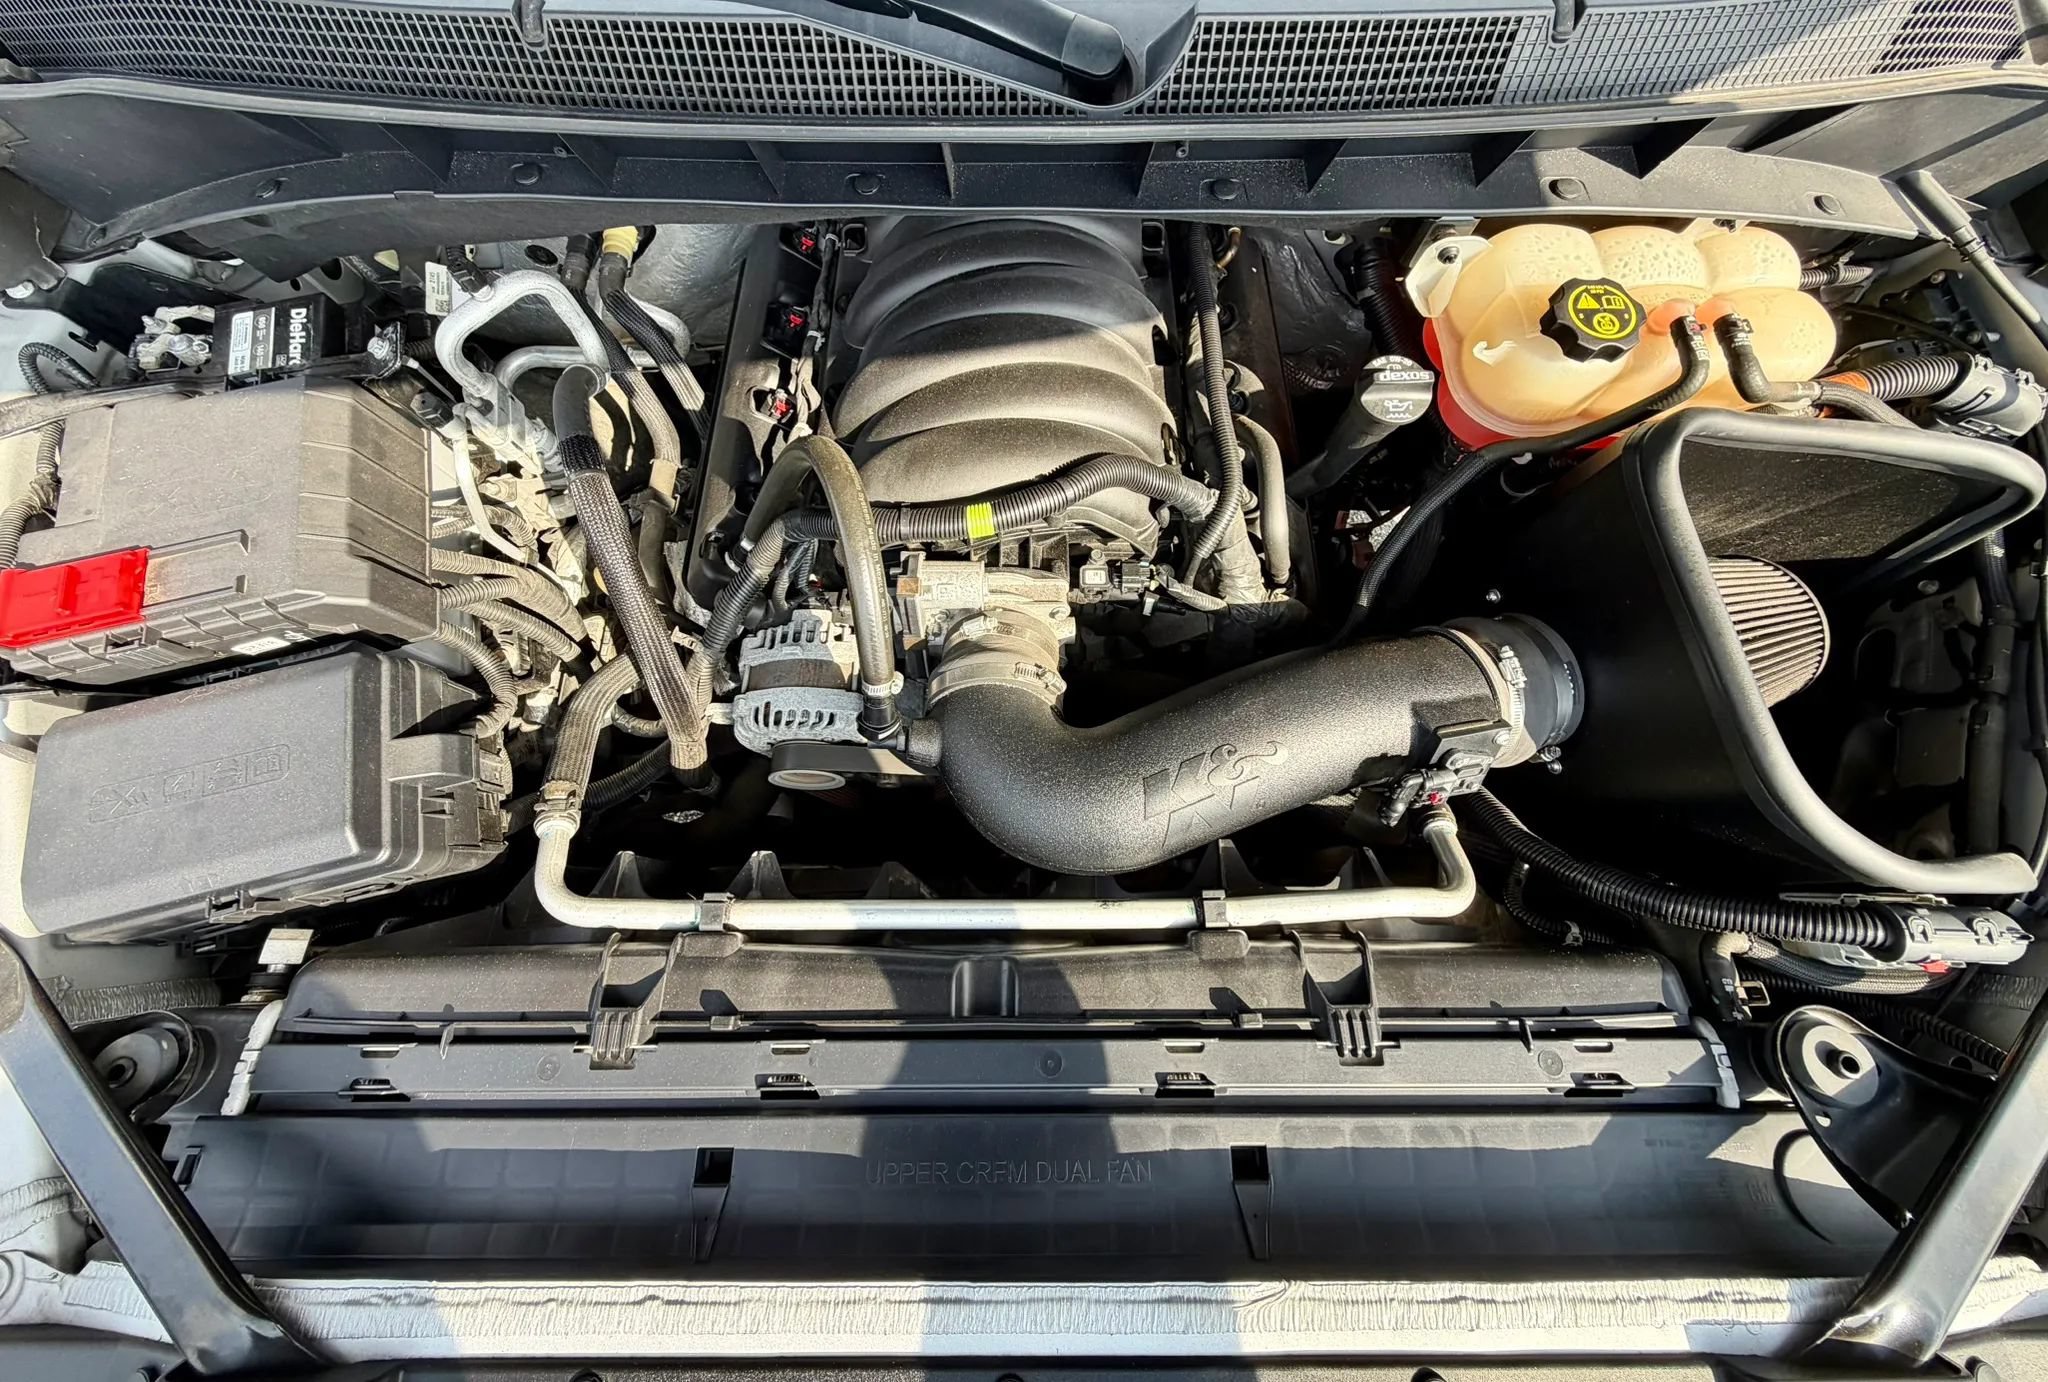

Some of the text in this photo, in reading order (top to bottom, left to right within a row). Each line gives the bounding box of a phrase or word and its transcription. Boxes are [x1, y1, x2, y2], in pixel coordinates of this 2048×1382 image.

[1372, 356, 1387, 367] SAE
[1380, 370, 1430, 381] dexos
[873, 563, 885, 593] Mexico
[866, 1159, 1152, 1184] UPPER CRFM DUAL FAN
